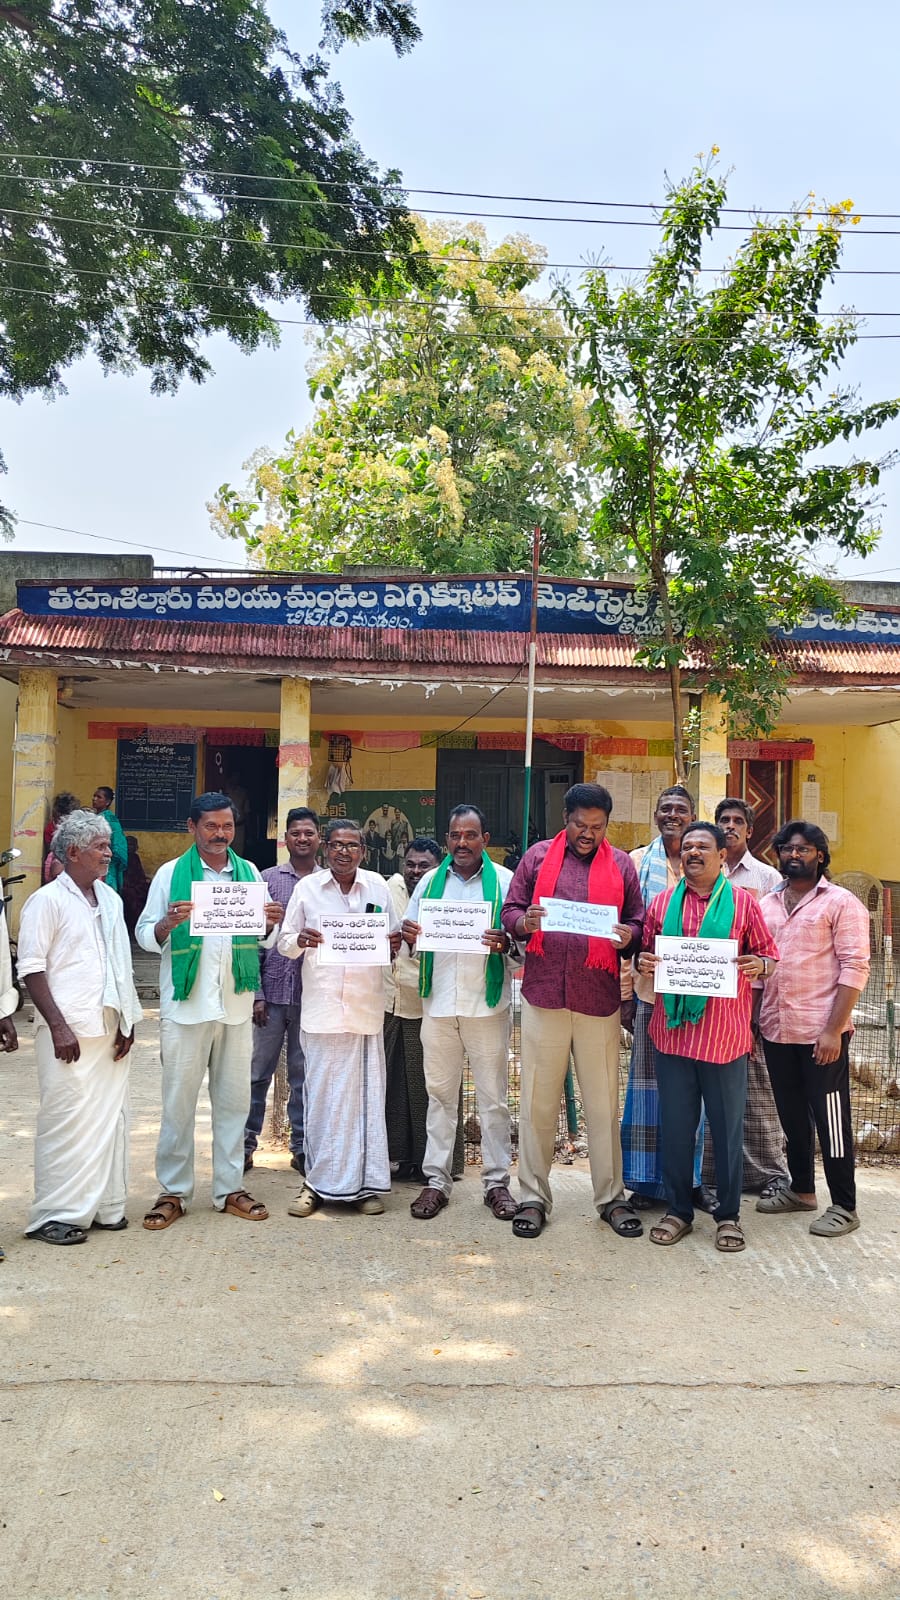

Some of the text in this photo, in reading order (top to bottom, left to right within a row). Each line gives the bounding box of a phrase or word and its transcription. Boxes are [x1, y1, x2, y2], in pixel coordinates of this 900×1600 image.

[197, 584, 281, 610] మరియు
[285, 583, 378, 609] మండల
[211, 886, 230, 894] 13.8
[227, 908, 255, 918] కుమార్
[234, 919, 263, 930] చేయాలి
[349, 941, 377, 951] చేయాలి
[680, 942, 711, 953] ఎన్నికల
[669, 978, 721, 990] కాపాడుదాం
